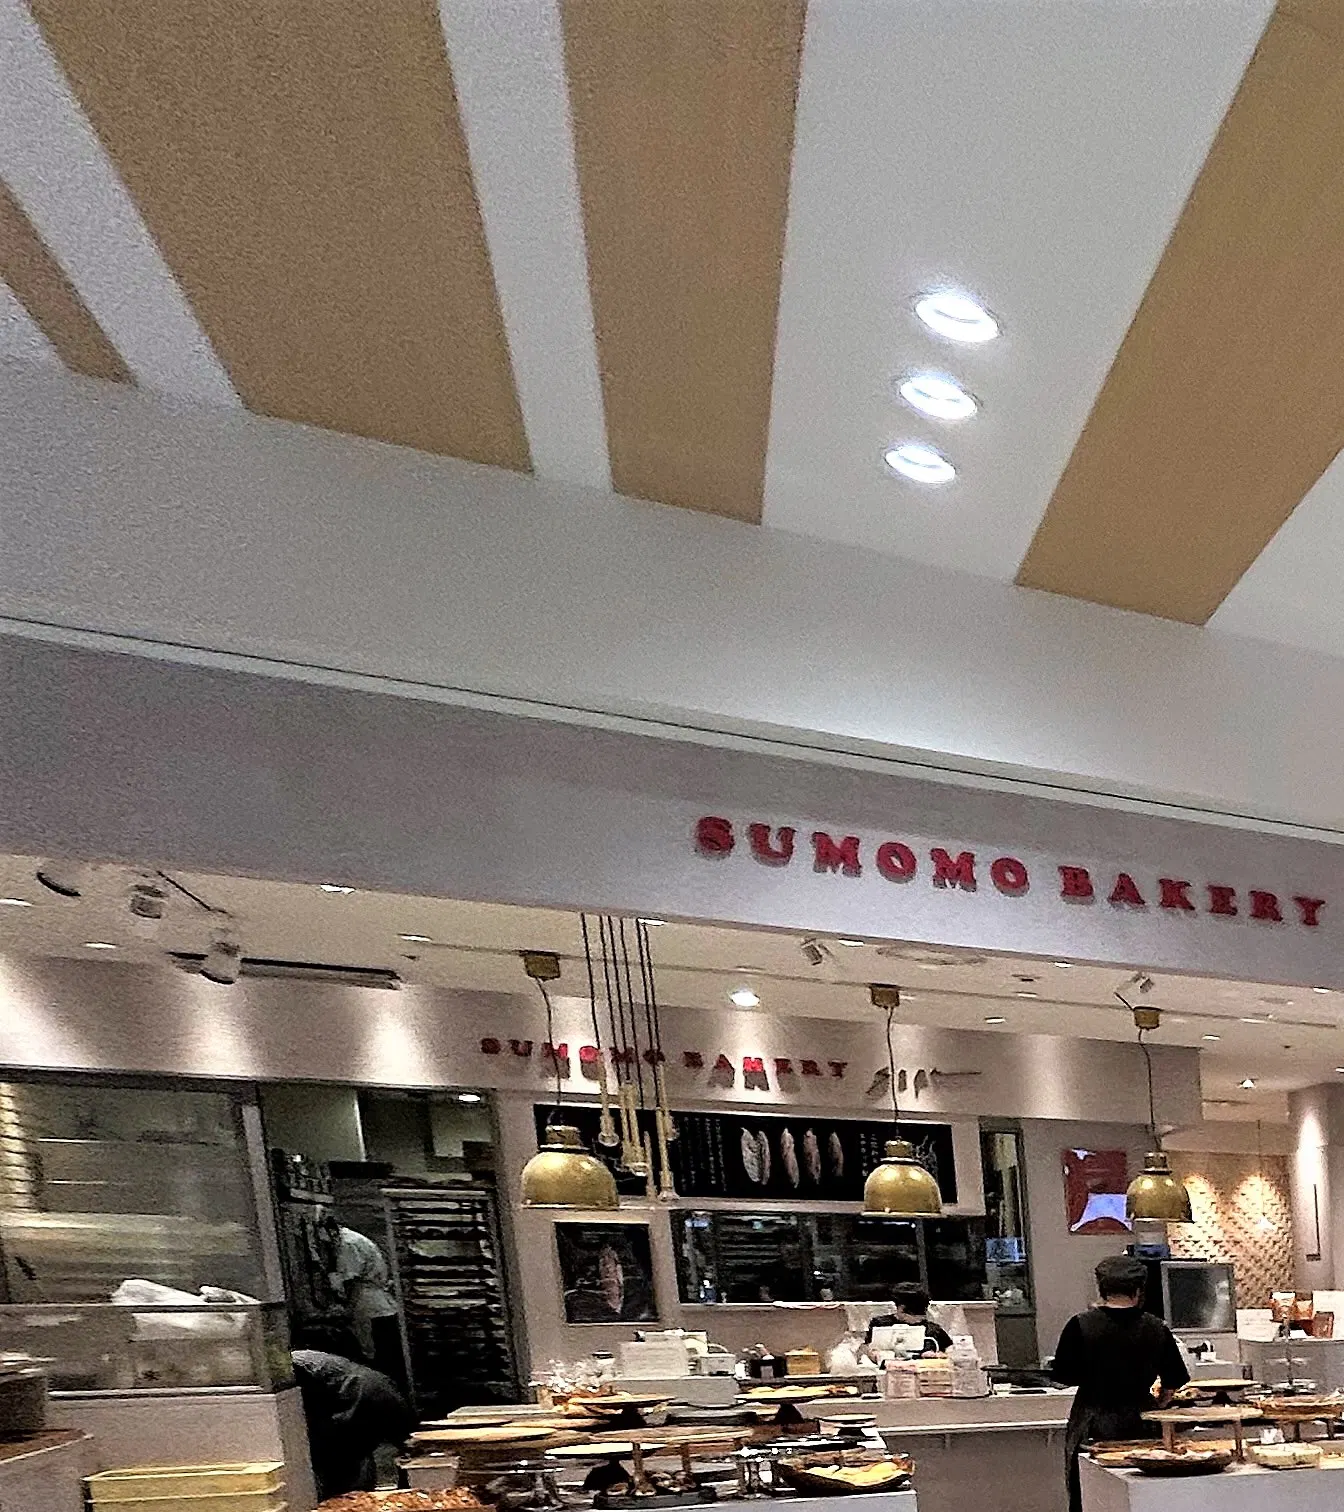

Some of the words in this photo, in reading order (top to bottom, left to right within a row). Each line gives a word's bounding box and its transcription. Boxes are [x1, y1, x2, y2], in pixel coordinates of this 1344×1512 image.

[695, 815, 1030, 897] SUMOMO
[1058, 865, 1325, 927] BAKERY
[481, 1038, 666, 1065] SUMOMO
[683, 1051, 848, 1079] BAKERY
